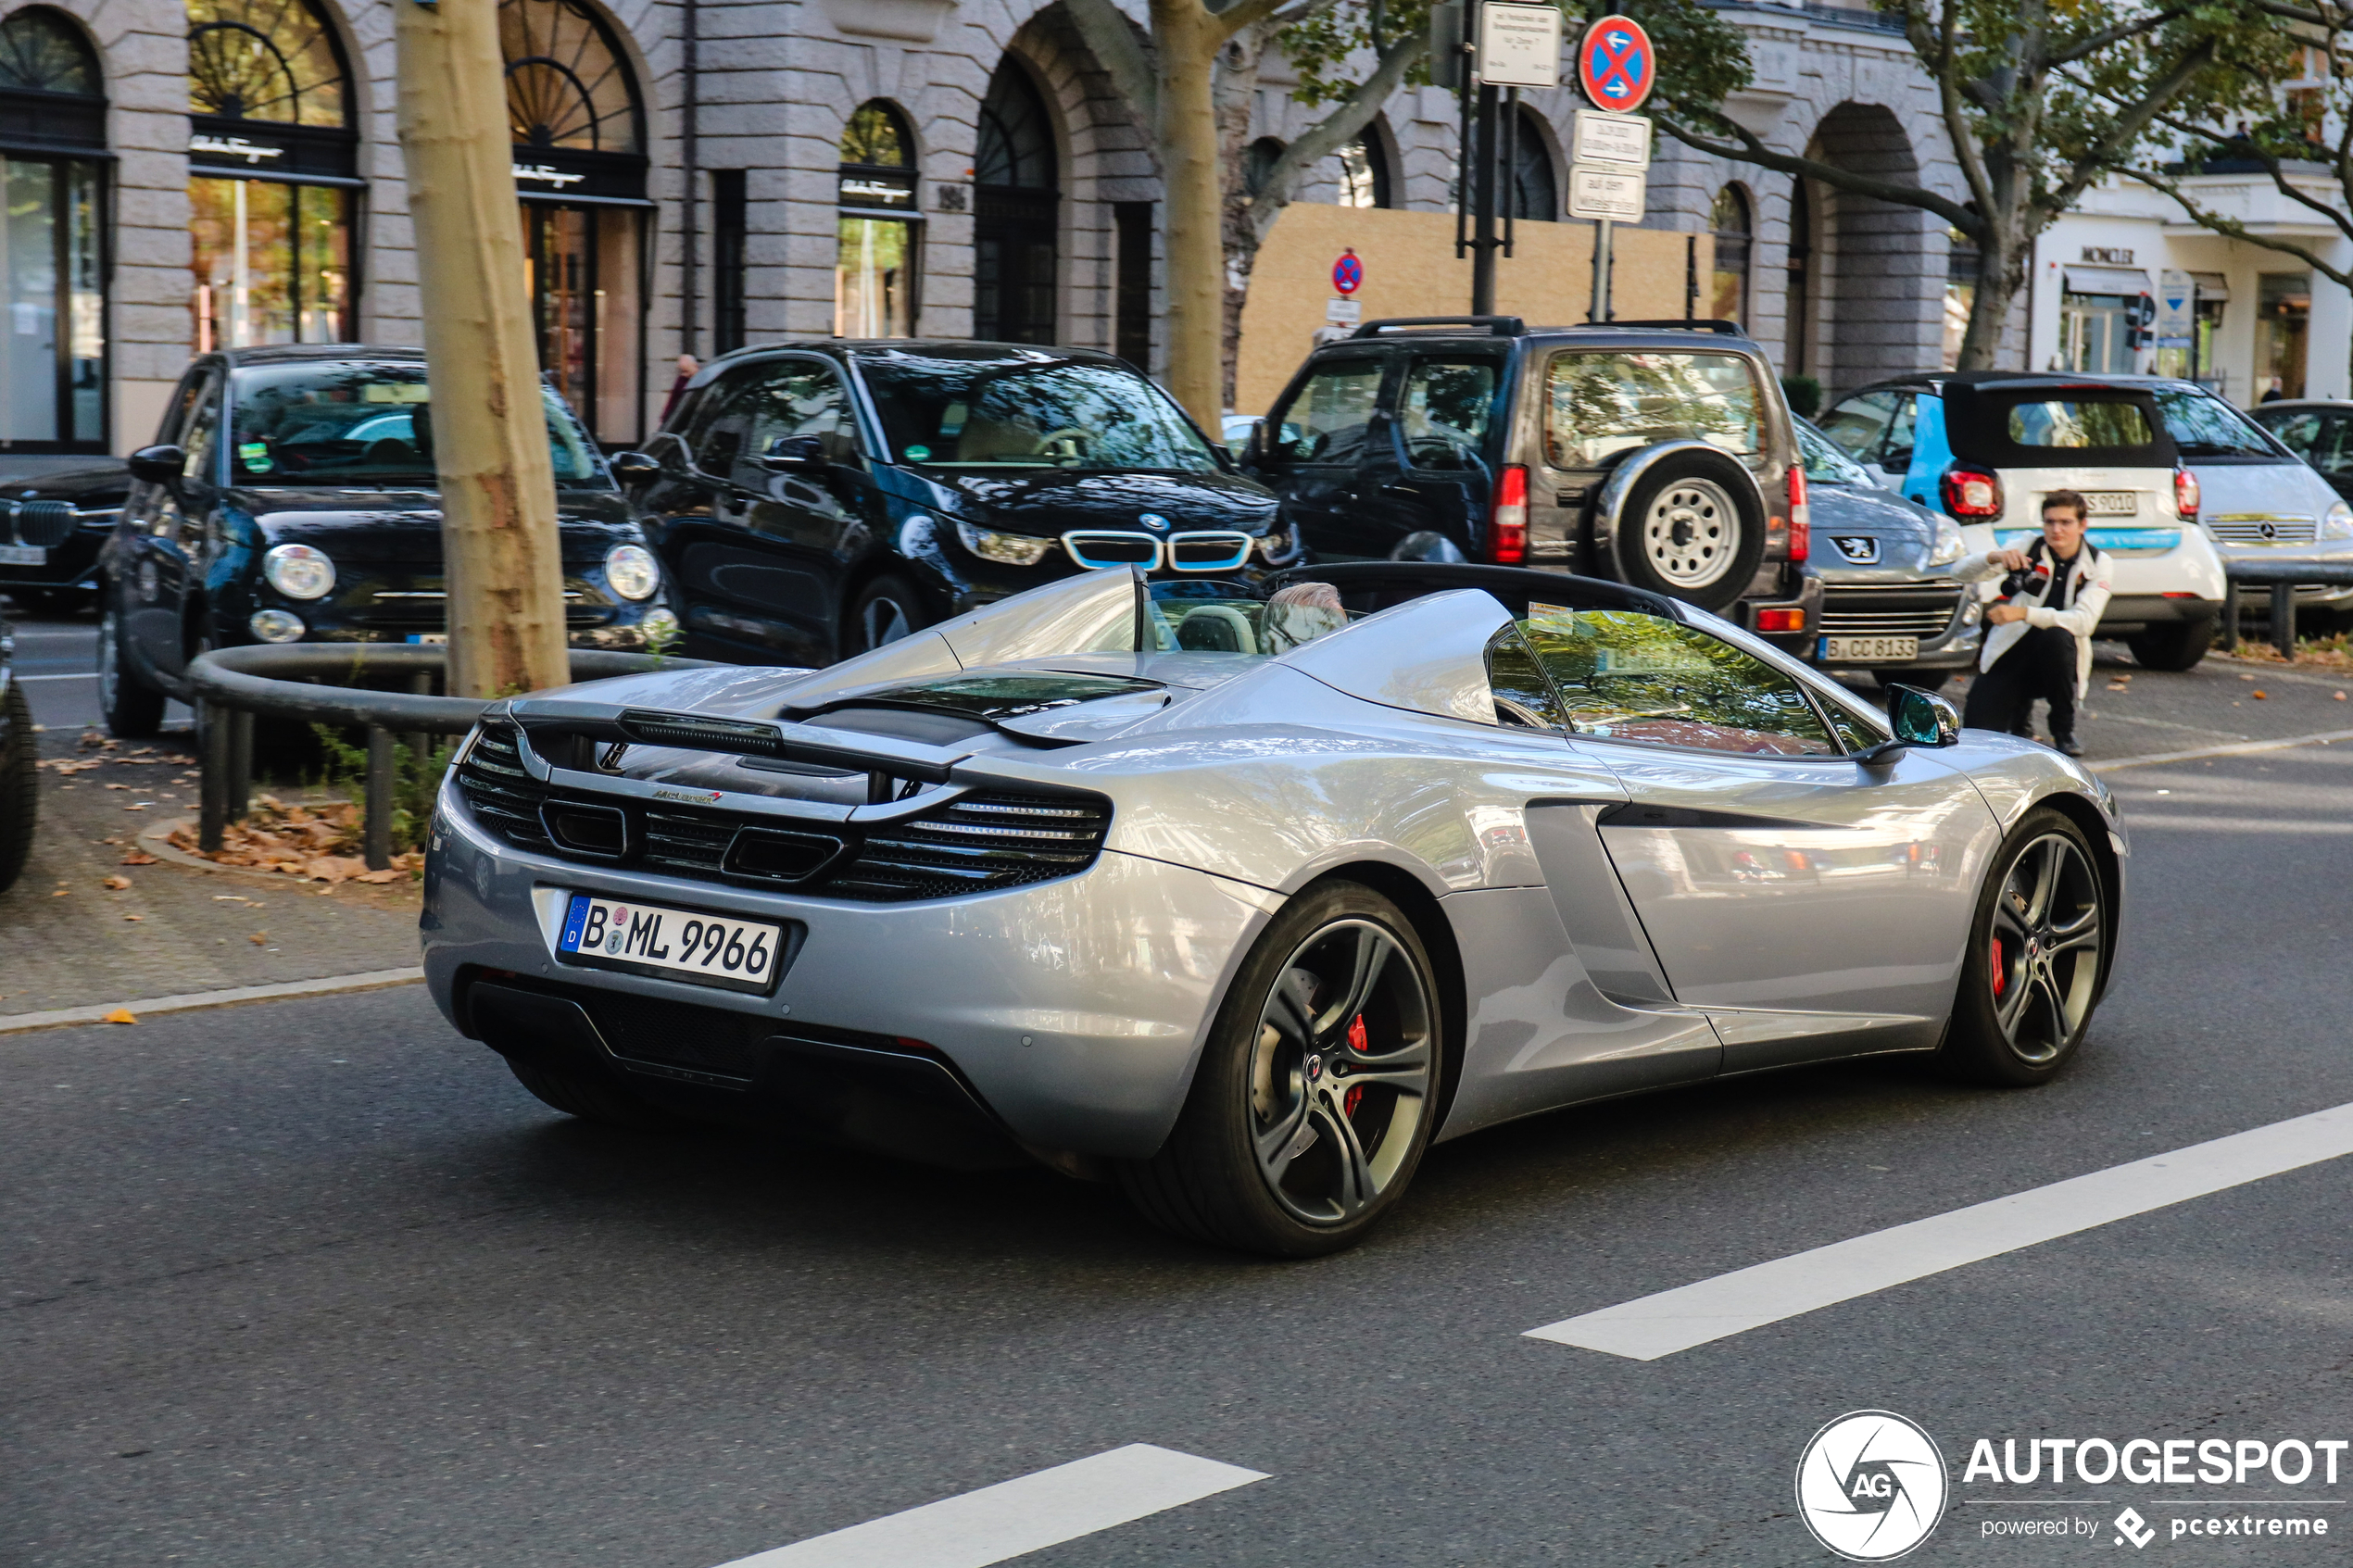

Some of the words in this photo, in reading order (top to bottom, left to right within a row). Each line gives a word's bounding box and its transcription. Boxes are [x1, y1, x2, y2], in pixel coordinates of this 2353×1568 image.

[2082, 246, 2133, 265] MONCLER
[1829, 640, 1839, 657] B
[1850, 640, 1870, 657] CC
[1875, 639, 1915, 657] 8133
[568, 930, 576, 943] D
[583, 905, 608, 947] B
[625, 910, 670, 959] ML
[679, 921, 768, 973] 9966
